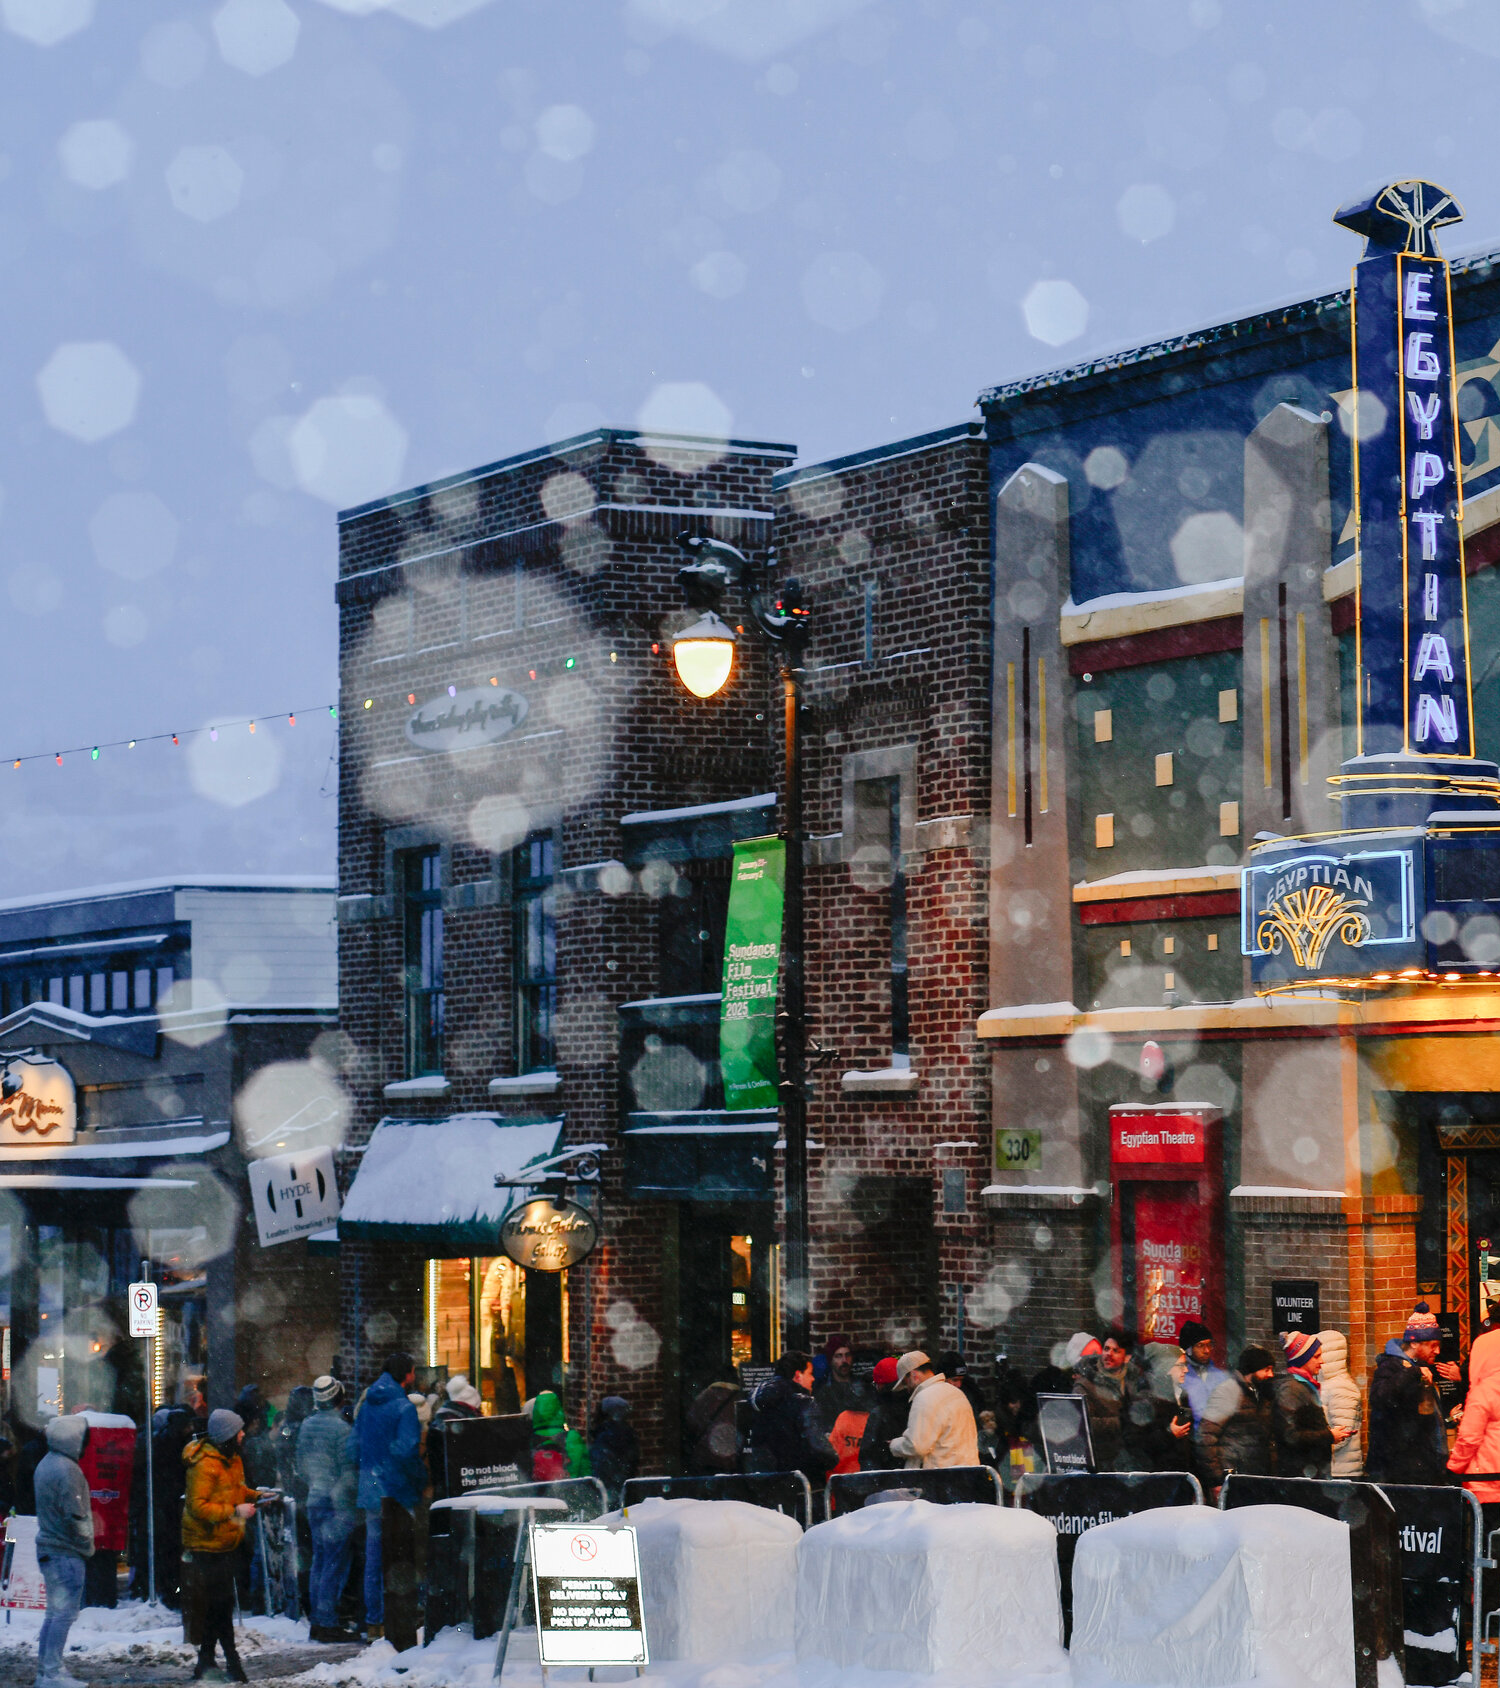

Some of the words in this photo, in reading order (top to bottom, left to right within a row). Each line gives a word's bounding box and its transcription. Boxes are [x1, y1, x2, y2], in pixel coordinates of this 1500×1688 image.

[1403, 271, 1459, 743] EGYPTIAN
[1266, 864, 1374, 911] EGYPTIAN
[729, 943, 776, 959] Sundance
[727, 963, 752, 978] Film
[726, 980, 772, 997] Festival
[725, 1002, 749, 1017] 2025
[1120, 1131, 1159, 1149] Egyptian
[1160, 1131, 1195, 1145] Theatre
[1006, 1137, 1030, 1161] 330
[280, 1182, 312, 1200] HYDE
[1275, 1297, 1314, 1309] VOLUNTEER
[1287, 1312, 1302, 1323] LINE
[1053, 1453, 1063, 1463] Do
[1063, 1454, 1072, 1463] not
[1072, 1454, 1086, 1465] block
[460, 1467, 475, 1477] Do
[476, 1465, 491, 1475] not
[493, 1463, 518, 1473] block
[461, 1477, 477, 1487] the
[478, 1473, 518, 1486] sidewalk
[561, 1580, 614, 1590] PERMITTED
[549, 1590, 602, 1600] DELIVERIES
[602, 1590, 627, 1600] ONLY
[552, 1607, 567, 1617] NO
[568, 1607, 594, 1617] DROP
[595, 1607, 613, 1617] OFF
[613, 1607, 628, 1617] OR
[550, 1617, 573, 1627] PICK
[574, 1617, 588, 1627] UP
[588, 1617, 632, 1627] ALLOWED
